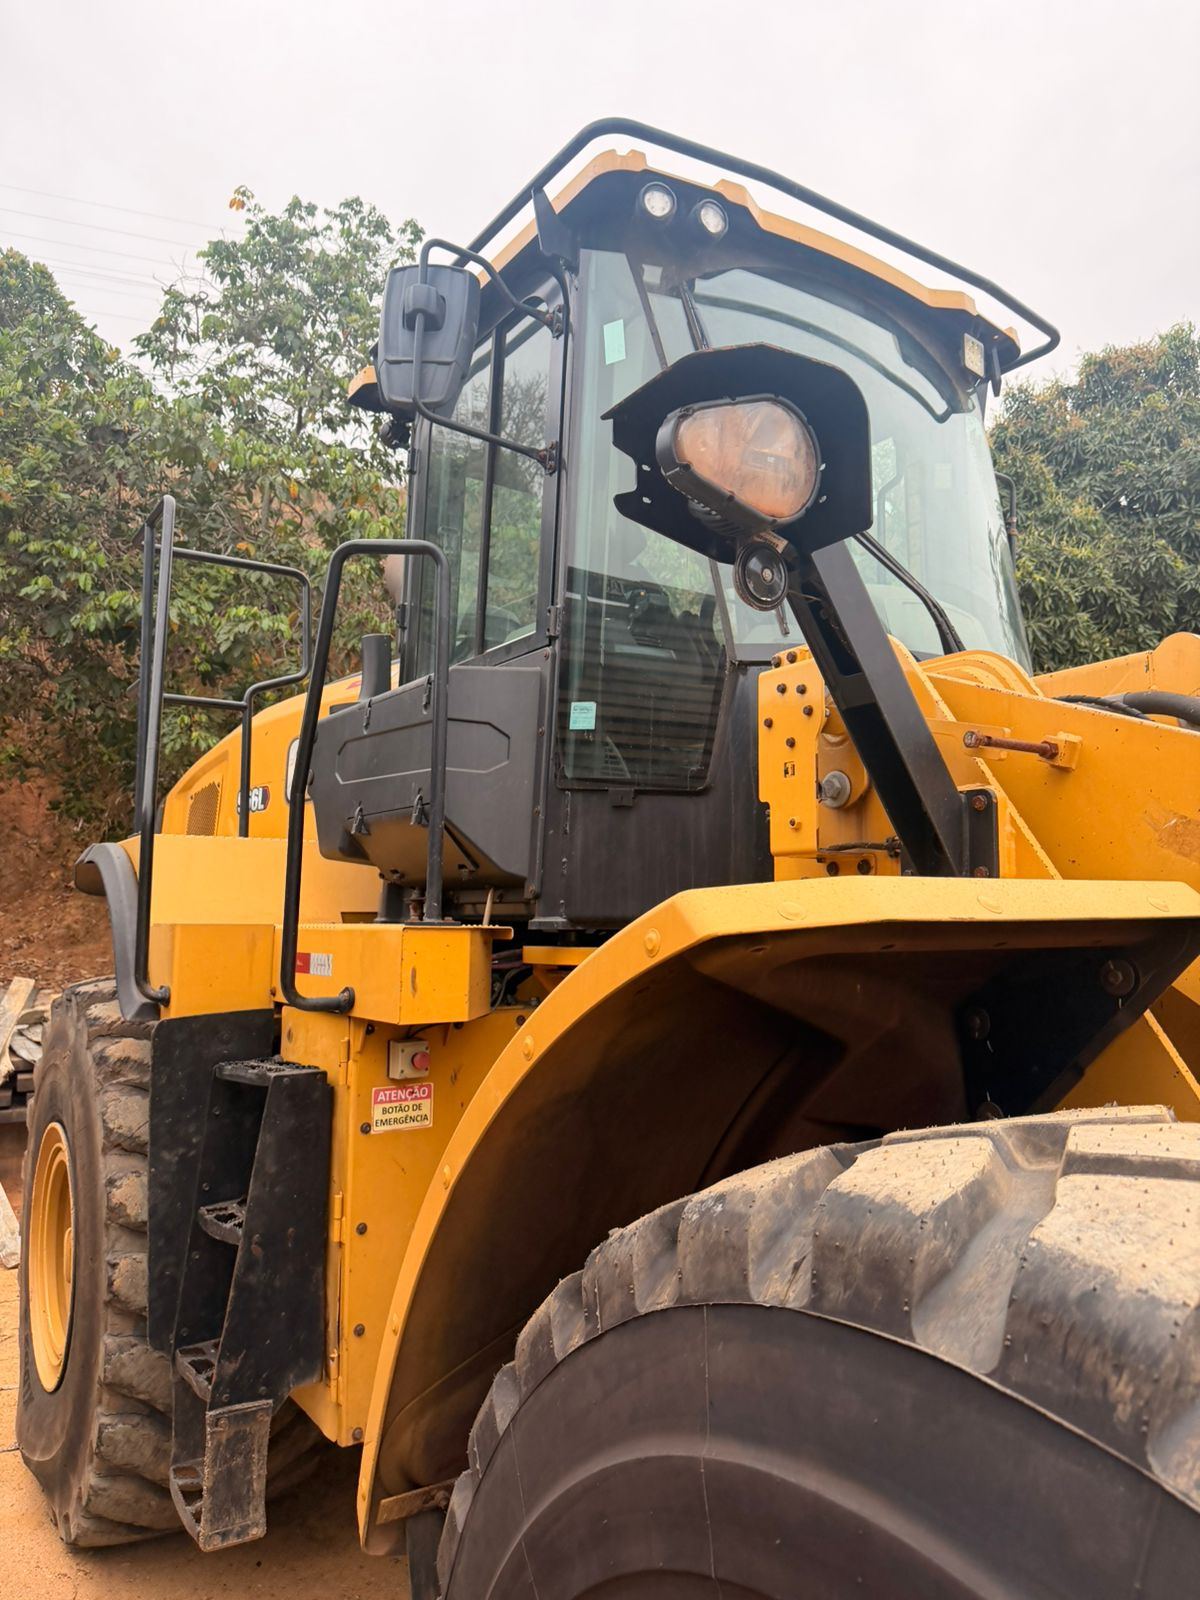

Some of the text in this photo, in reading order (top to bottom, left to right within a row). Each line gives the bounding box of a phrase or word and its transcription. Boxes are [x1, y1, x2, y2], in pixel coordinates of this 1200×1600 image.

[237, 787, 265, 813] 6L
[377, 1086, 429, 1102] ATENÇÃO
[382, 1103, 423, 1115] BOTÃO DE
[375, 1114, 429, 1127] EMERGÊNCIA
